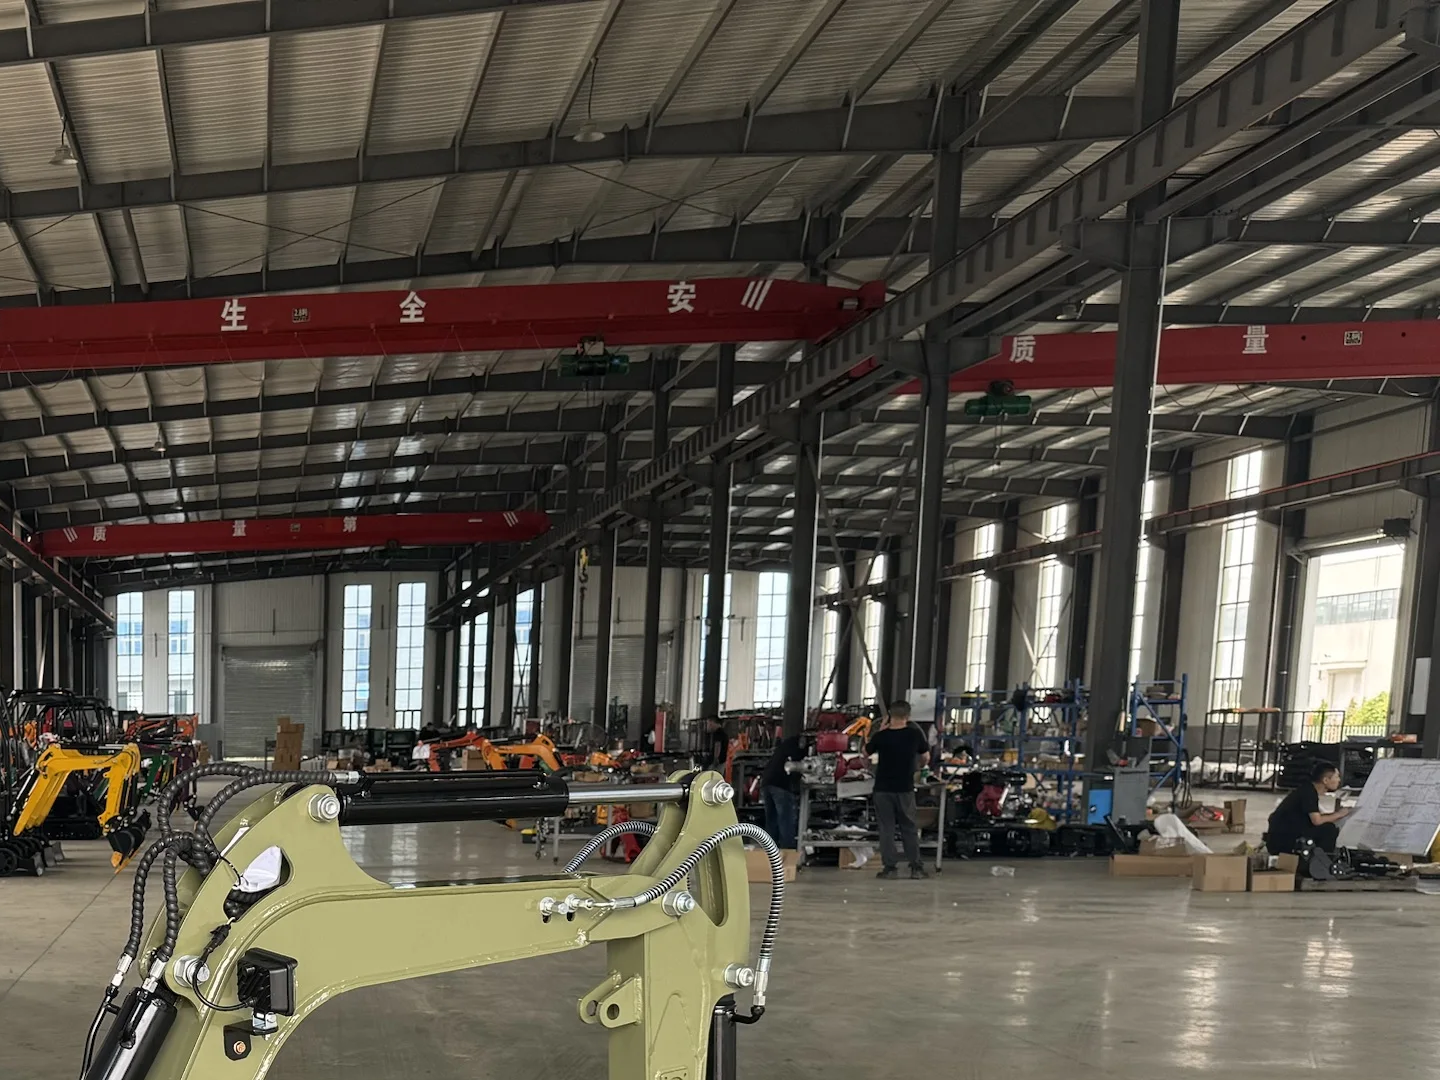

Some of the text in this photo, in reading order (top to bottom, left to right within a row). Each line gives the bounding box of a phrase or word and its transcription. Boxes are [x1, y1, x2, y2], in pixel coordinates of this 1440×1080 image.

[221, 299, 247, 331] 生
[399, 291, 426, 323] 全
[667, 281, 696, 313] 安
[1010, 325, 1269, 363] 质 量
[93, 526, 106, 541] 质
[232, 520, 246, 536] 量
[343, 515, 357, 532] 第
